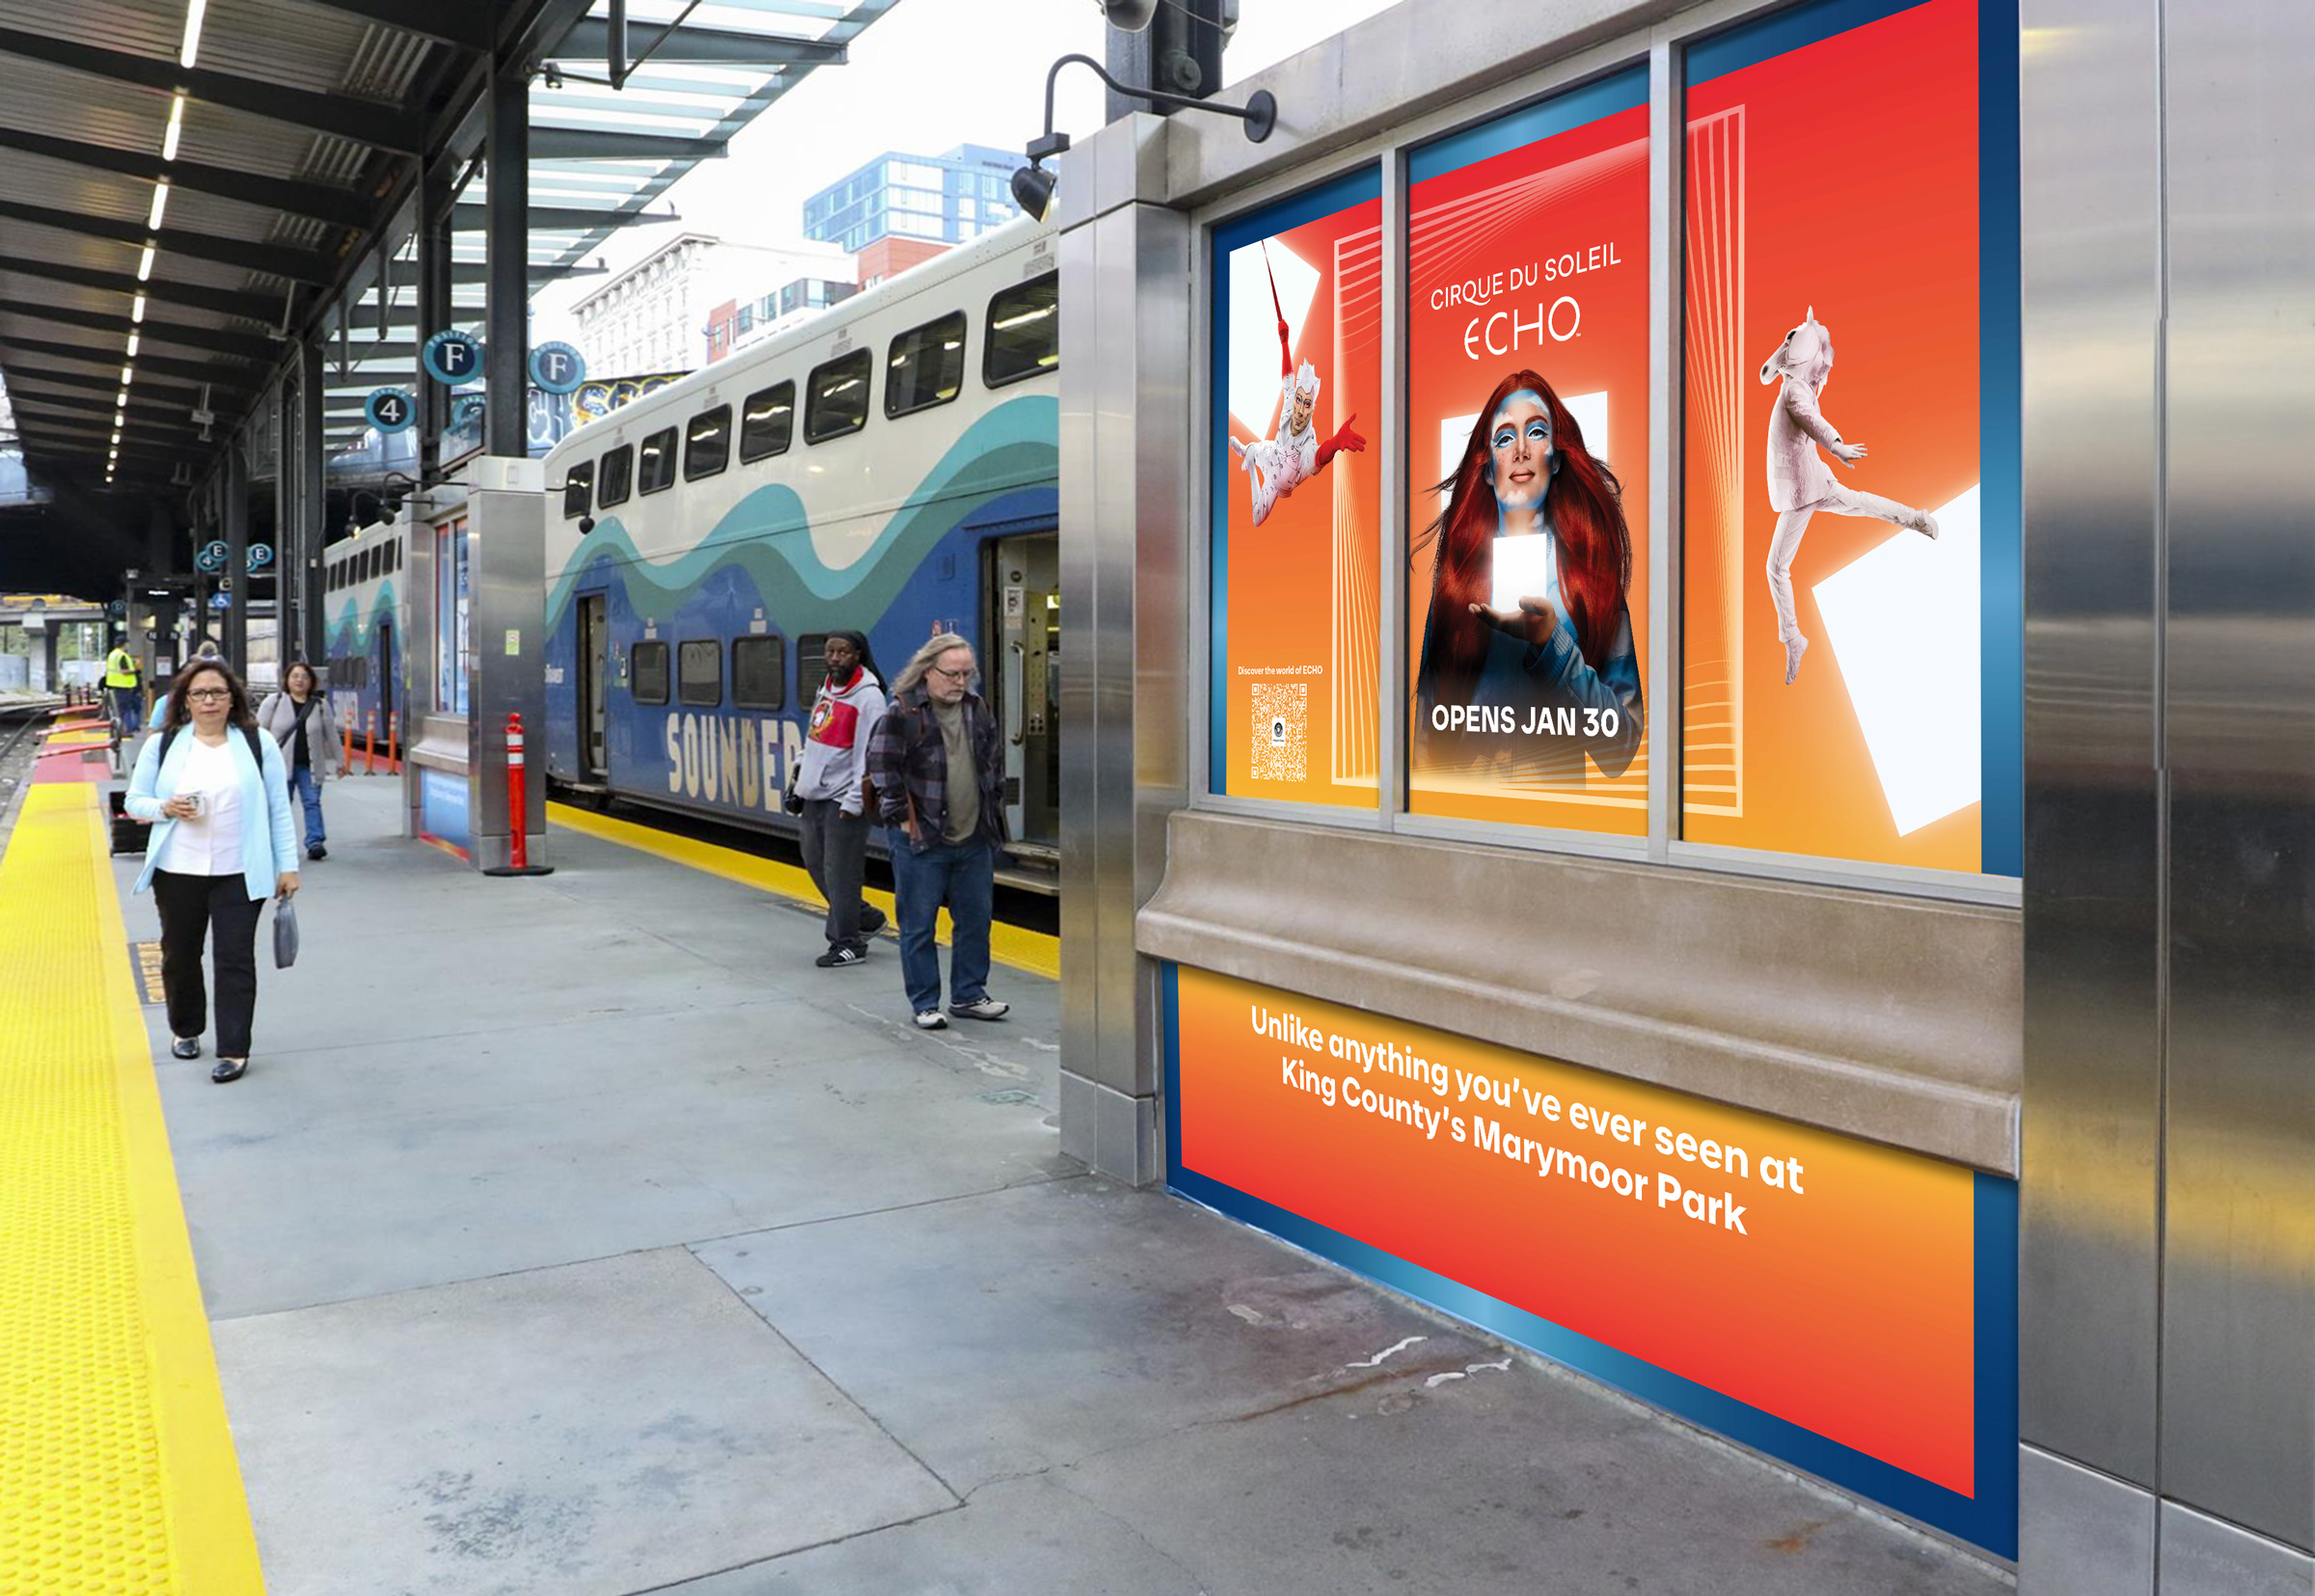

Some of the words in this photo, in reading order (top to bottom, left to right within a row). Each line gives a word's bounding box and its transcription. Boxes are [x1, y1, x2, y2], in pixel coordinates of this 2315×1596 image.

[1431, 272, 1504, 311] CIRQUE
[1511, 262, 1538, 291] DU
[1545, 242, 1621, 282] SOLEIL
[1464, 296, 1581, 361] ECHO
[444, 342, 465, 371] F
[548, 352, 568, 381] F
[379, 398, 401, 422] 4
[213, 545, 223, 557] E
[256, 548, 265, 560] E
[1238, 665, 1265, 675] Discover
[1266, 665, 1275, 675] the
[1276, 665, 1294, 675] world
[1295, 665, 1302, 675] of
[1302, 664, 1323, 675] ECHO
[1431, 704, 1516, 734] OPENS
[1520, 706, 1576, 736] JAN
[1582, 707, 1620, 738] 30
[1251, 1005, 1323, 1052] Unlike
[1328, 1034, 1449, 1096] anything
[1455, 1069, 1562, 1122] you've
[1568, 1102, 1647, 1147] ever
[1654, 1125, 1749, 1178] seen
[1759, 1155, 1805, 1195] at
[1282, 1056, 1336, 1107] King
[1342, 1076, 1466, 1143] County's
[1474, 1115, 1648, 1202] Marymoor
[1657, 1172, 1749, 1235] Park
